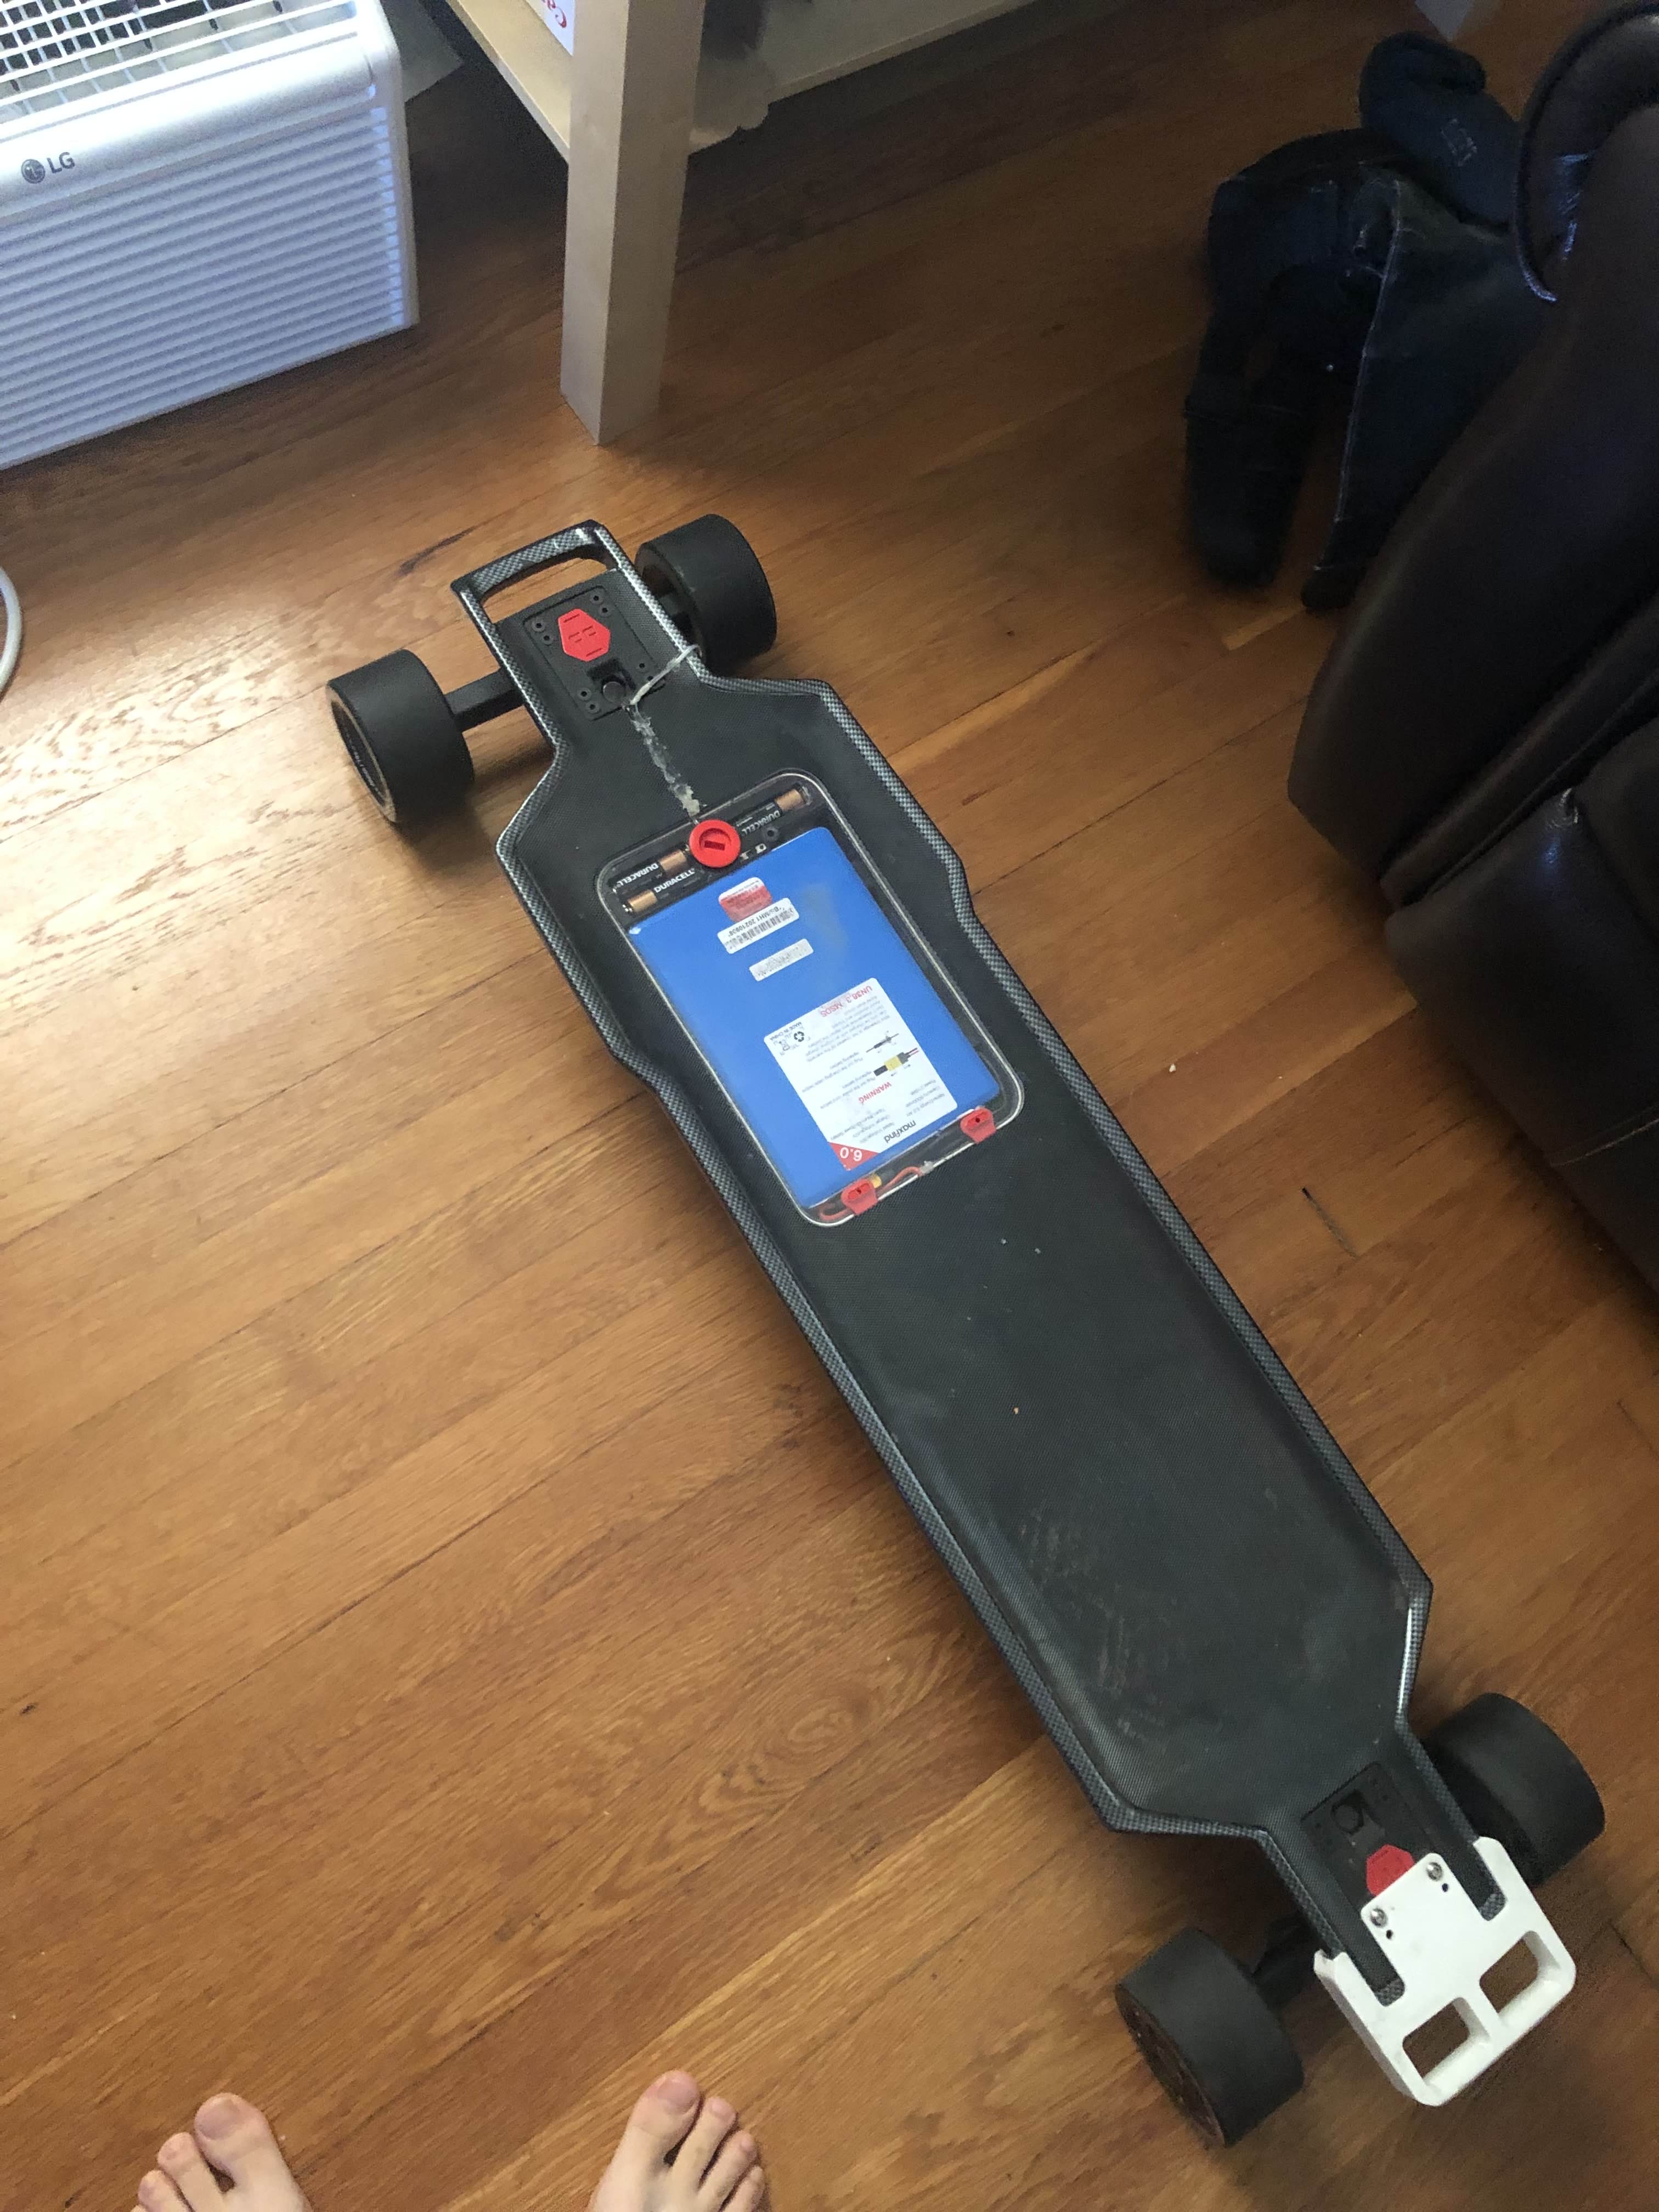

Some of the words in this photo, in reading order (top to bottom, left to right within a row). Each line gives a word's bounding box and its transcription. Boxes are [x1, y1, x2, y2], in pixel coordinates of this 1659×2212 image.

[47, 152, 75, 174] LG
[742, 810, 781, 834] DURACELL
[617, 862, 659, 887] DURACELL
[654, 869, 695, 893] DURACELL
[769, 1031, 784, 1041] CHINA
[788, 1021, 802, 1030] MADE
[857, 1080, 892, 1104] WARNING
[882, 1119, 917, 1144] maxfind
[839, 1147, 862, 1161] 6.0
